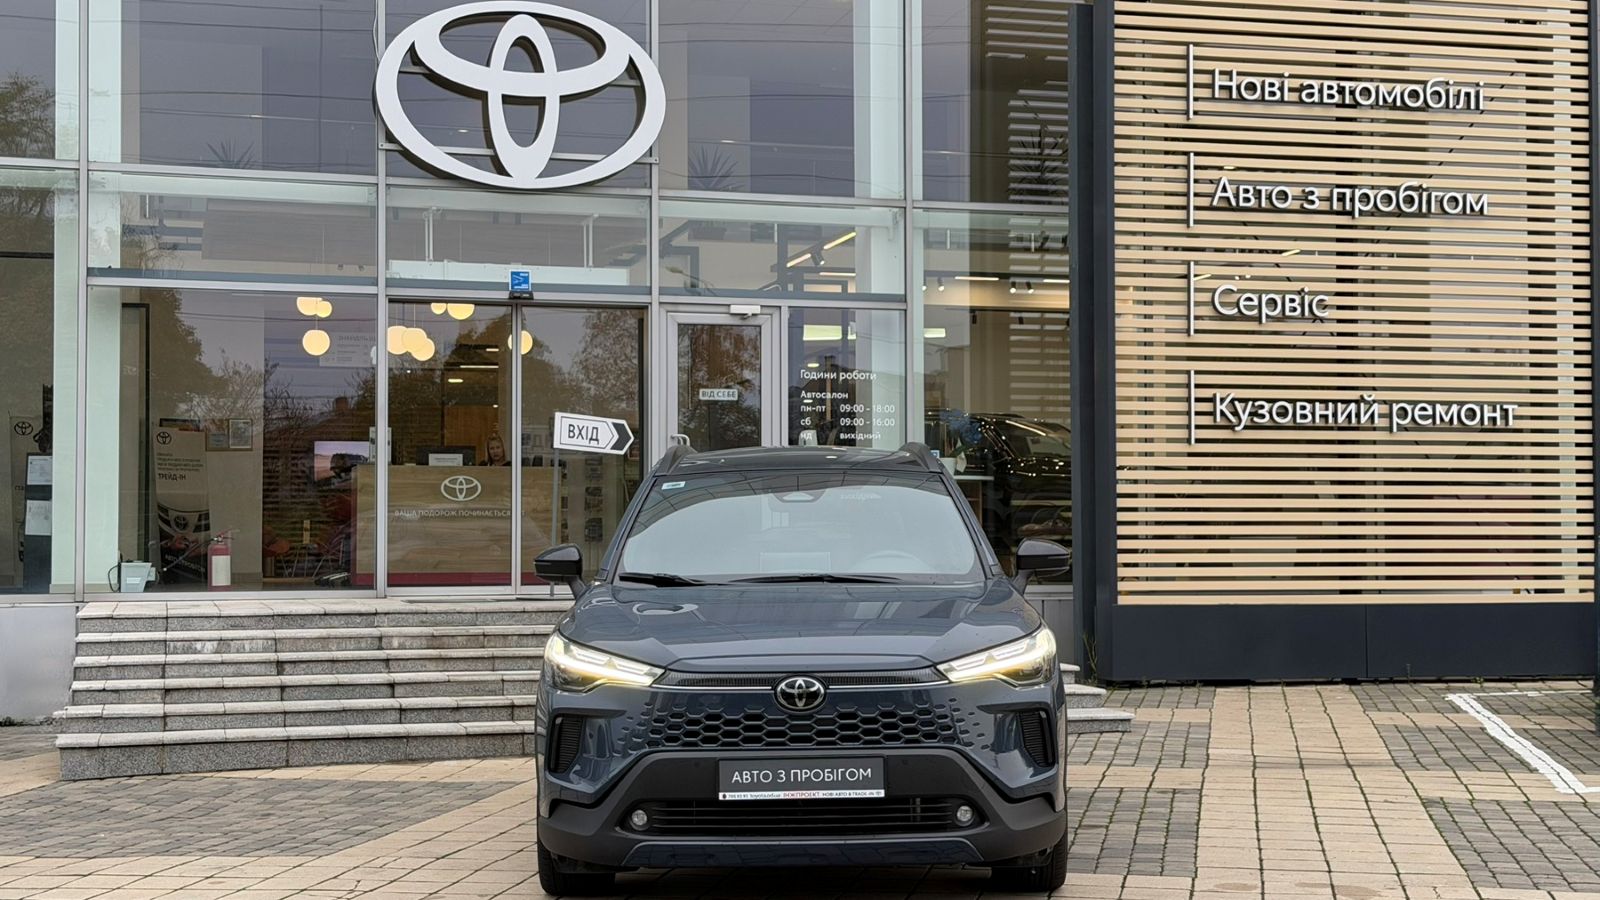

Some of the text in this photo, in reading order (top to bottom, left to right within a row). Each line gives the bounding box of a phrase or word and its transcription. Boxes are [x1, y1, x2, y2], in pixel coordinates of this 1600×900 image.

[1212, 68, 1485, 110] Нові автомобілі
[1211, 176, 1489, 219] Авто з пробігом
[1213, 284, 1330, 323] Сервіс
[800, 369, 876, 385] Години роботи
[701, 390, 737, 399] ВІД СЕБЕ
[800, 390, 849, 399] Автосалон
[800, 405, 826, 413] пн-пт
[839, 404, 864, 413] 09:00
[872, 404, 895, 413] 18:00
[1213, 393, 1518, 432] Кузовний ремонт
[800, 417, 812, 426] сб
[839, 417, 864, 427] 09:00
[872, 417, 895, 427] 16:00
[567, 423, 600, 445] ВХІД
[800, 430, 881, 442] нд вихідний
[394, 509, 511, 517] ВАША ПОДОРОЖ ПОЧИНАЄТЬСЯ
[731, 768, 872, 784] АВТО З ПРОБІГОМ
